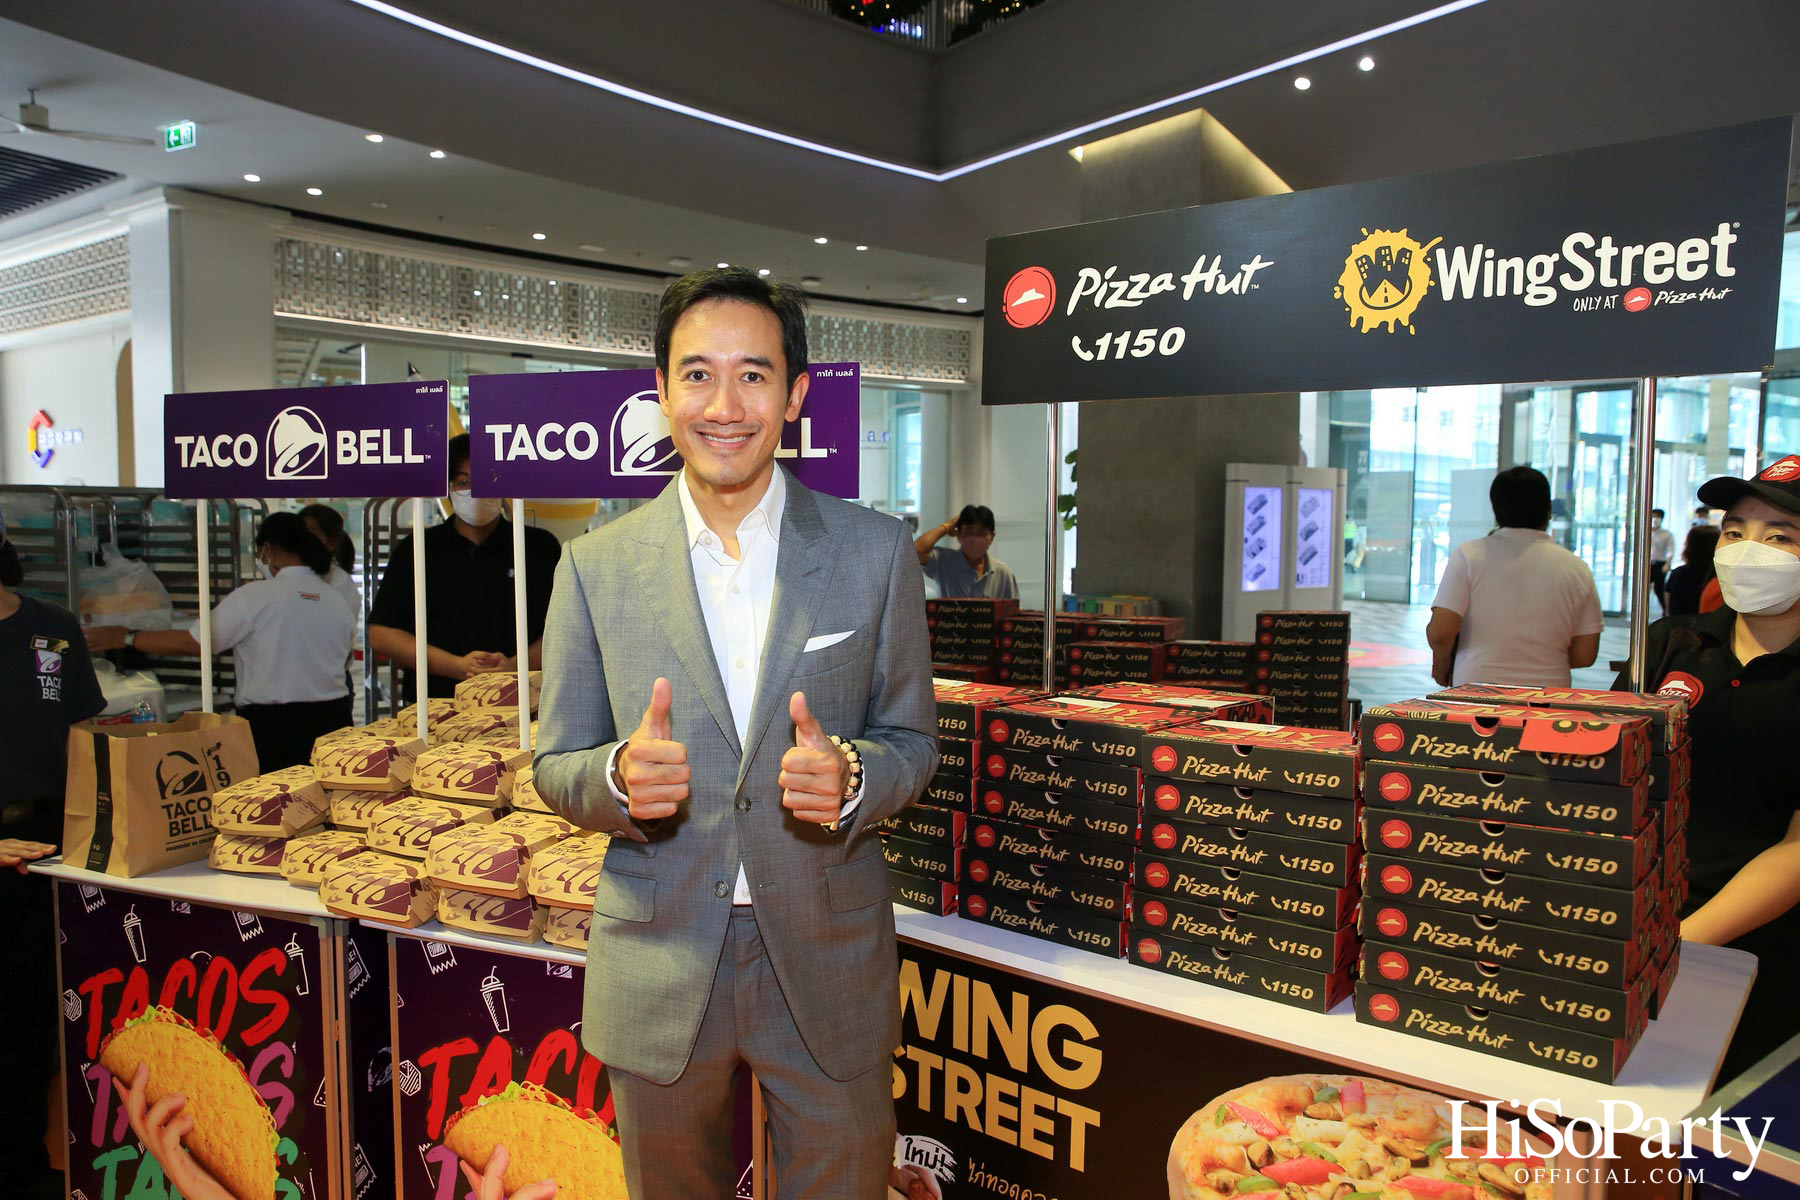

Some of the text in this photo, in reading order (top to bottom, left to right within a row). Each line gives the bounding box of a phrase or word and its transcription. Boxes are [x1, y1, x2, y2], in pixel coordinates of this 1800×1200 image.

[1435, 222, 1738, 307] WingStreet
[1066, 254, 1274, 317] Pizza Hut
[1573, 287, 1733, 312] ONLY AT Pizza Hut
[1094, 327, 1186, 361] 1150
[174, 428, 425, 468] TACO BELL
[484, 416, 828, 462] TACO LL
[938, 717, 967, 731] 1150
[1013, 728, 1136, 757] Pizza Hut 1150
[1410, 734, 1470, 757] Pizza
[1472, 741, 1520, 762] Hut
[1010, 764, 1127, 796] Pizza Hut 1150
[1182, 755, 1340, 788] Pizza Hut 1150
[161, 797, 212, 820] TACO
[935, 788, 964, 803] 1150
[1185, 795, 1342, 831] Pizza Hut 1150
[1417, 783, 1617, 821] Pizza Hut 1150
[918, 823, 945, 838] 1150
[1008, 801, 1128, 834] Pizza Hut 1150
[918, 857, 946, 873] 1150
[1000, 835, 1124, 871] Pizza Hut 1150
[1182, 835, 1334, 874] Pizza Hut 1150
[1418, 832, 1618, 875] Pizza Hut 1150
[907, 890, 935, 906] 1150
[992, 871, 1114, 909] Pizza Hut 1150
[1174, 874, 1325, 917] Pizza Hut 1150
[1418, 878, 1617, 925] Pizza Hut 1150
[991, 906, 1111, 947] Pizza Hut 1150
[1172, 913, 1323, 959] Pizza Hut 1150
[1413, 922, 1609, 975] Pizza Hut 1150
[1166, 951, 1314, 1000] Pizza Hut 1150
[1414, 966, 1611, 1022] Pizza Hut 1150
[1405, 1009, 1598, 1069] Pizza Hut 1150
[904, 1137, 946, 1172] ใหม่!
